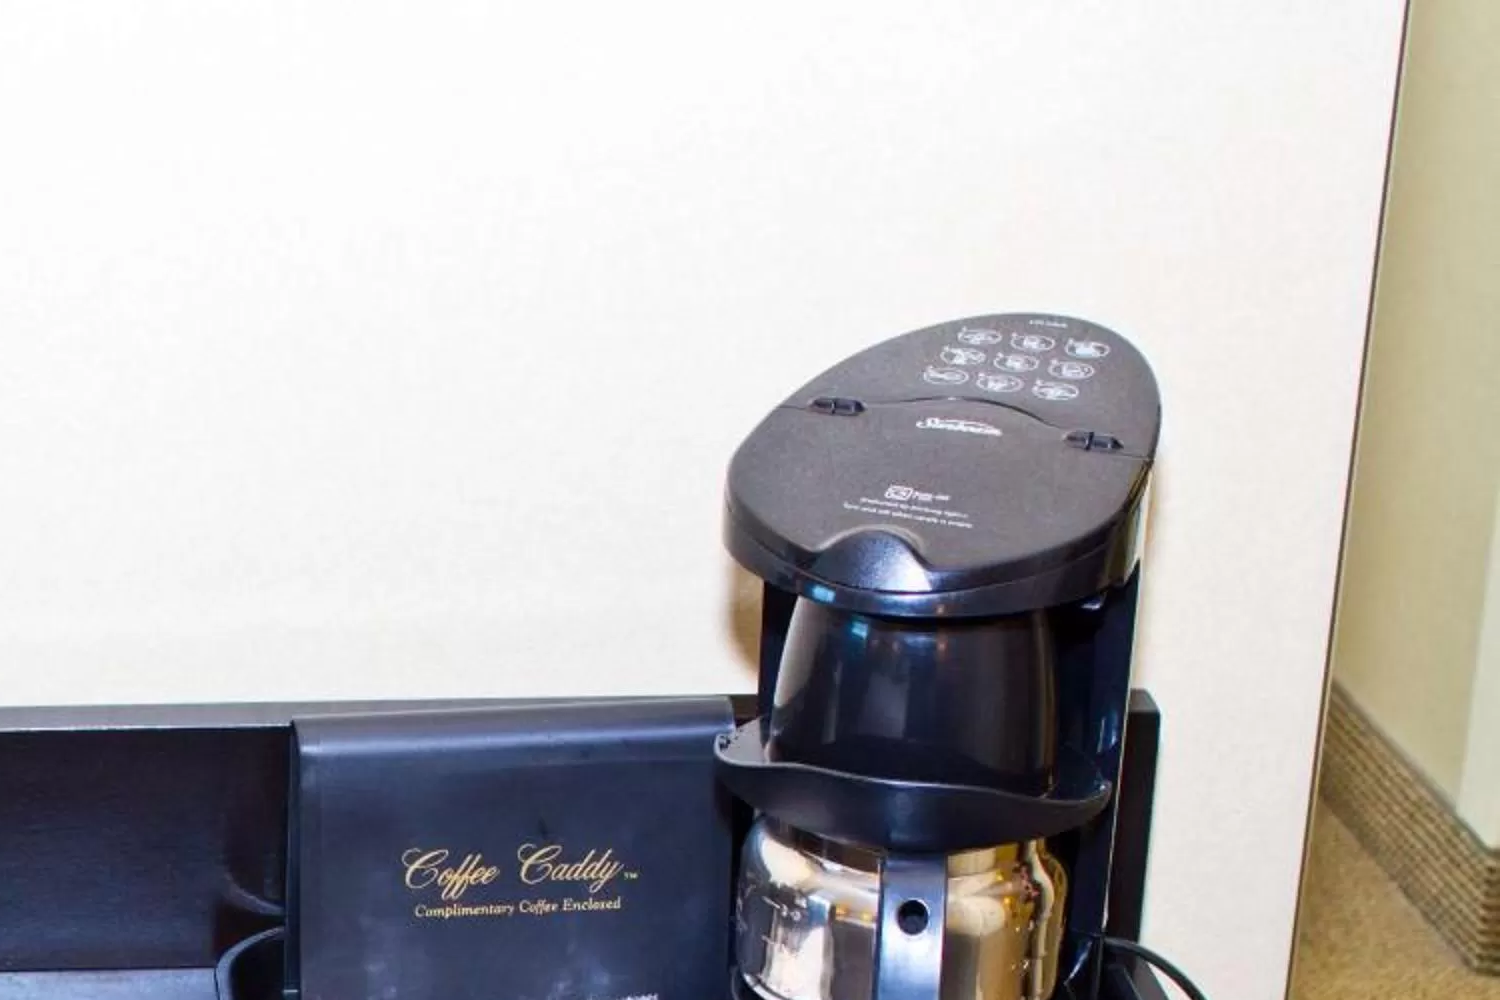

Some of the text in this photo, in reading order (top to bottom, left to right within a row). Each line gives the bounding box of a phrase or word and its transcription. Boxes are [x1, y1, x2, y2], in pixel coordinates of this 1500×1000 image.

[401, 847, 499, 900] Coffee
[517, 843, 623, 893] Caddy
[415, 897, 621, 920] Complimentary Coffee Enclosed
